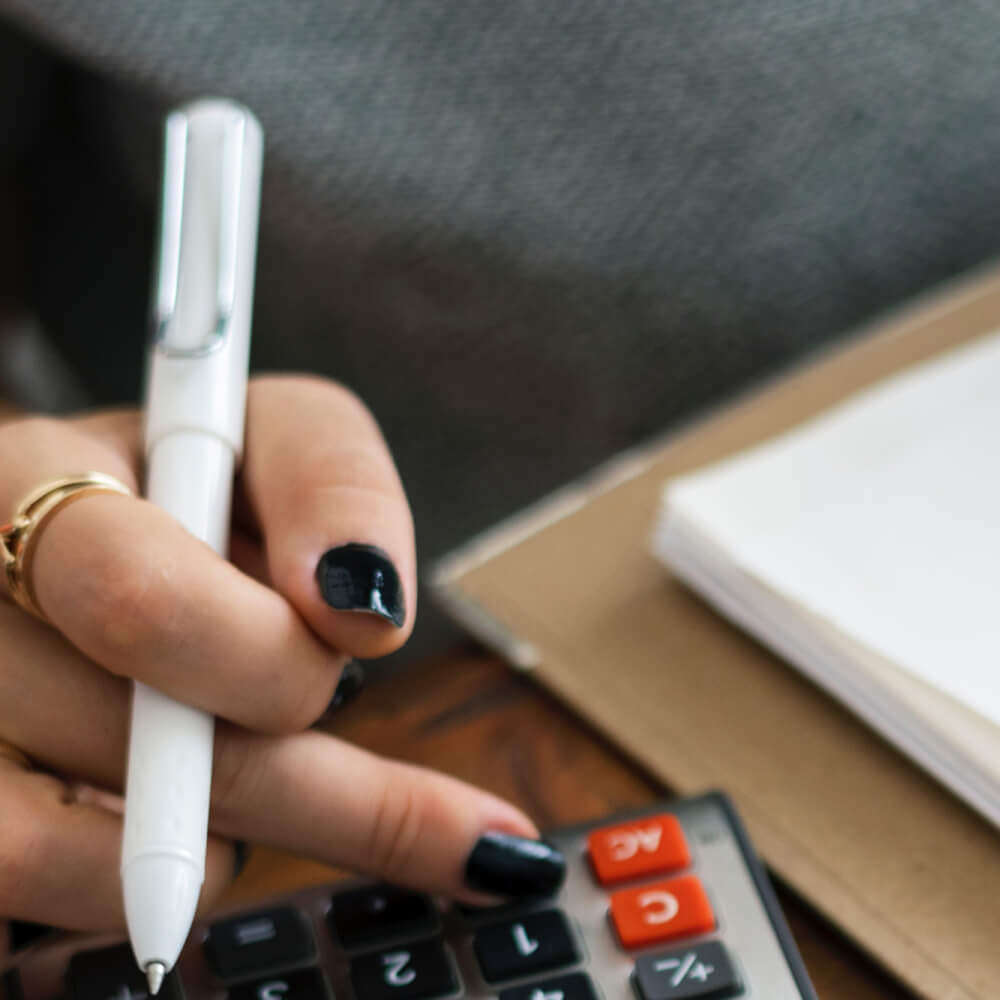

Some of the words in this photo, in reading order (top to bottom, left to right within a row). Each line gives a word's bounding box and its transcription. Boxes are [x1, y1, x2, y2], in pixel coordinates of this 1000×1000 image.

[609, 825, 663, 861] AC
[639, 890, 679, 925] C
[513, 923, 539, 955] 1
[383, 951, 417, 986] 2
